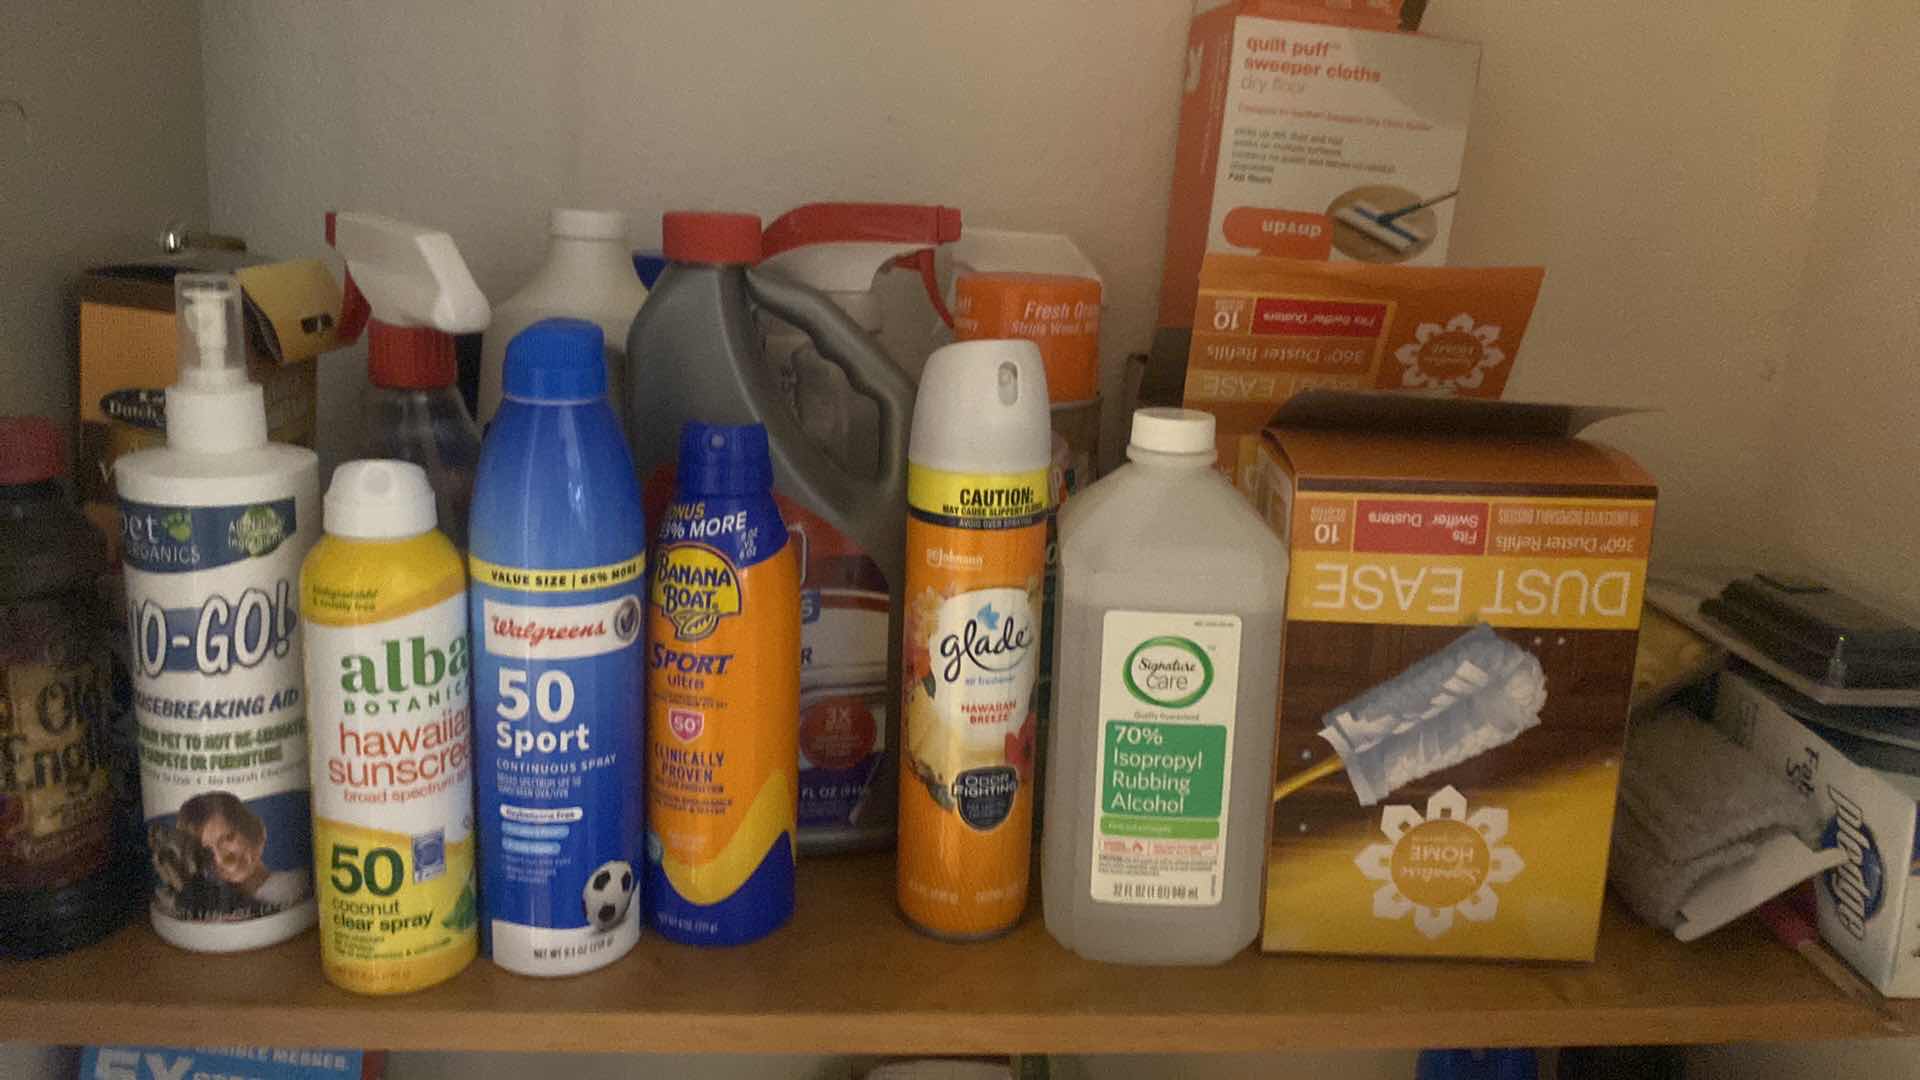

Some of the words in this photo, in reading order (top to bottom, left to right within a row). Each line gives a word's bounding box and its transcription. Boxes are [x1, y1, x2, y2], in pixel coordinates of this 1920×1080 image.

[1247, 37, 1286, 55] quilt
[1292, 39, 1331, 57] puff
[1244, 57, 1319, 77] sweeper
[1326, 64, 1381, 83] cloths
[1262, 217, 1322, 238] up&up
[1024, 300, 1071, 321] Fresh
[1213, 310, 1240, 330] 10
[1264, 347, 1320, 364] Duster
[960, 487, 1034, 506] CAUTION:
[942, 504, 960, 514] MAY
[1368, 510, 1423, 528] Dusters
[689, 511, 747, 538] MORE
[1431, 512, 1479, 529] Swiffer
[1313, 523, 1340, 544] 10
[1452, 530, 1478, 545] Fits
[1496, 534, 1547, 551] Refills
[1549, 535, 1599, 552] Duster
[491, 570, 529, 586] VALUE
[535, 574, 566, 587] SIZE
[612, 563, 637, 579] MORE
[658, 551, 732, 588] BANANA
[1311, 562, 1462, 613] EASE
[1480, 568, 1632, 617] DUST
[663, 585, 716, 615] BOAT
[492, 614, 607, 648] Walgreens
[651, 643, 735, 675] SPORT
[941, 616, 1033, 683] glade
[341, 634, 470, 694] alba
[1138, 656, 1197, 673] Signature
[270, 688, 299, 711] AID
[496, 667, 575, 723] 50
[961, 701, 1017, 714] HAWAIIAN
[970, 713, 1009, 725] BREEZE
[184, 732, 203, 750] TO
[496, 720, 590, 757] Sport
[1114, 725, 1163, 745] 70%
[496, 758, 577, 775] CONTINUOUS
[581, 753, 617, 771] SPRAY
[1113, 747, 1203, 772] Isopropyl
[662, 760, 713, 783] PROVEN
[965, 773, 1009, 787] ODOR
[1112, 769, 1190, 796] Rubbing
[344, 786, 387, 803] broad
[1111, 791, 1184, 814] Alcohol
[556, 810, 576, 819] free
[1411, 847, 1473, 863] HOME
[331, 841, 404, 897] 50
[333, 897, 401, 916] coconut
[334, 912, 375, 931] clear
[380, 908, 436, 934] spray
